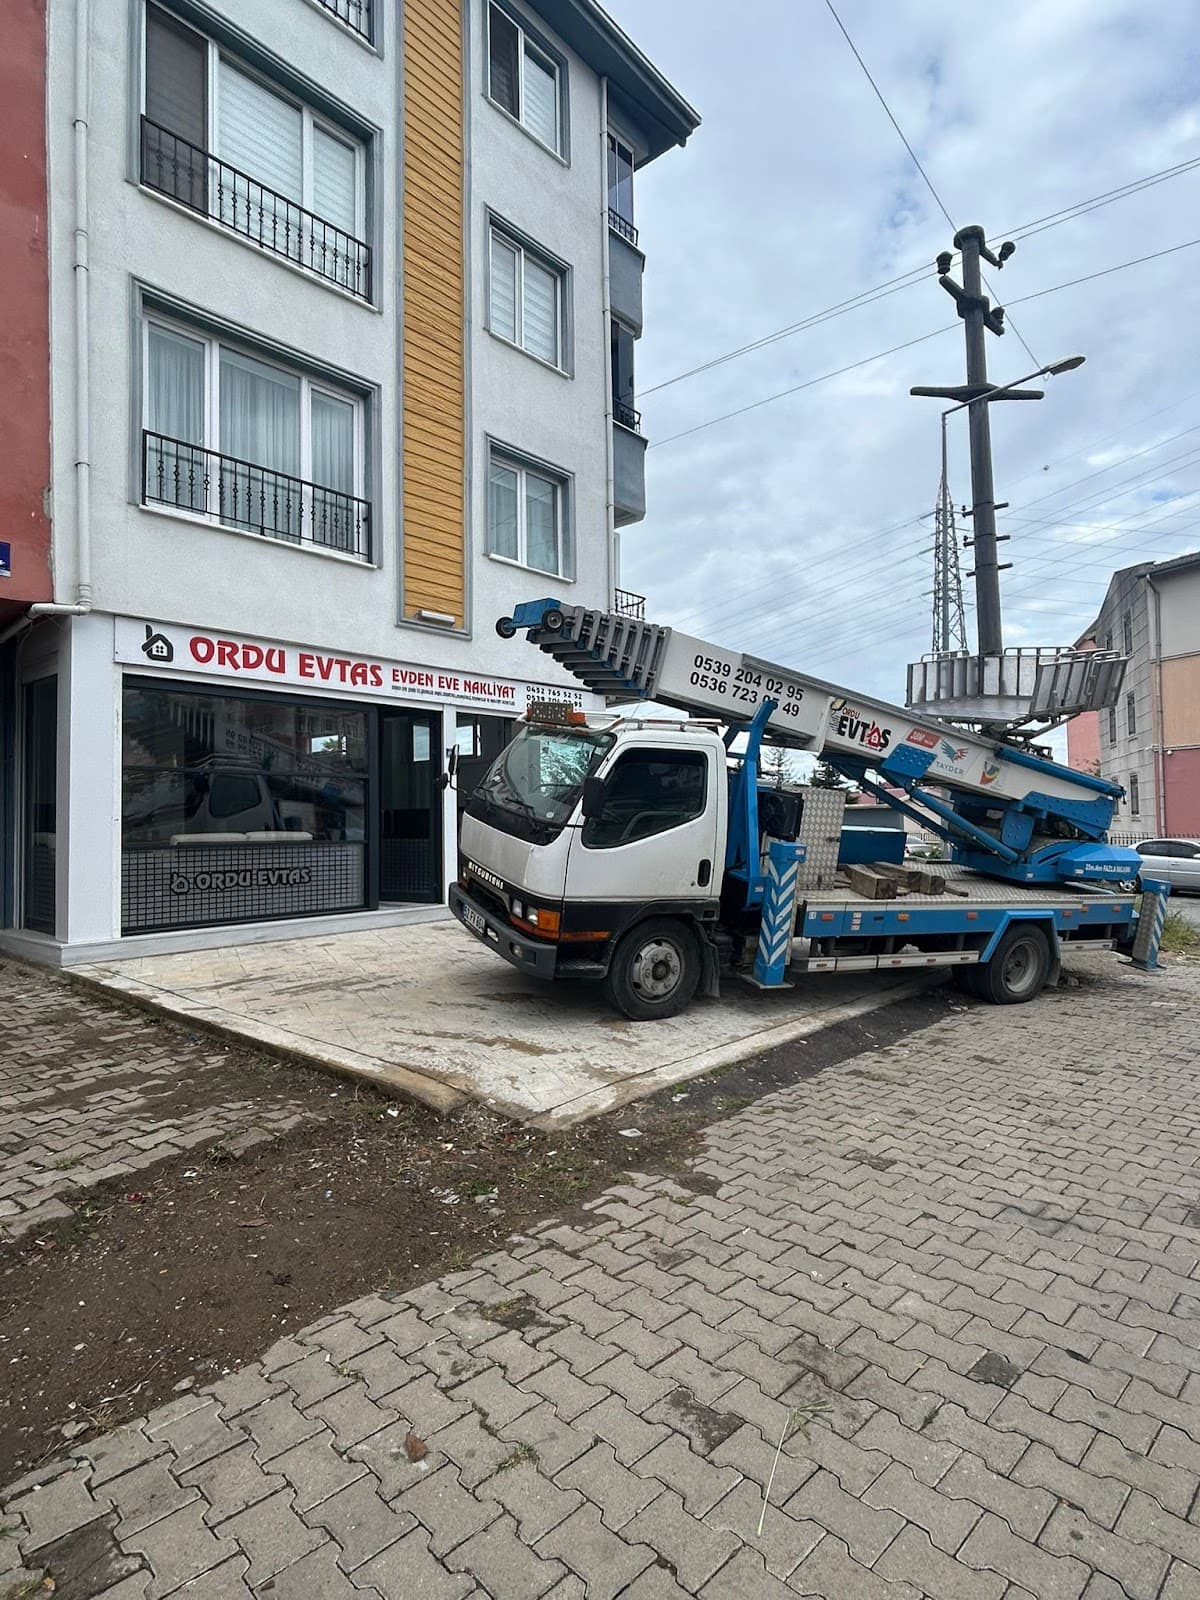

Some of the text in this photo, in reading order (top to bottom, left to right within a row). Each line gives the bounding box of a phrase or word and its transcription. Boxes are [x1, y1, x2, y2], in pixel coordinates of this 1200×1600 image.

[189, 636, 383, 687] ORDU EVTAS
[392, 668, 434, 688] EVDEN
[438, 676, 460, 691] EVE
[463, 680, 516, 699] NAKLİYAT
[694, 655, 804, 701] 0539 204 02 95
[526, 686, 545, 695] 0452
[548, 689, 561, 697] 765
[563, 691, 572, 699] 52
[690, 672, 728, 694] 0536
[732, 684, 758, 703] 723
[782, 702, 800, 717] 49
[842, 707, 860, 720] ORDU
[936, 761, 965, 776] TAYDER
[195, 867, 312, 891] ORDU EVTAS
